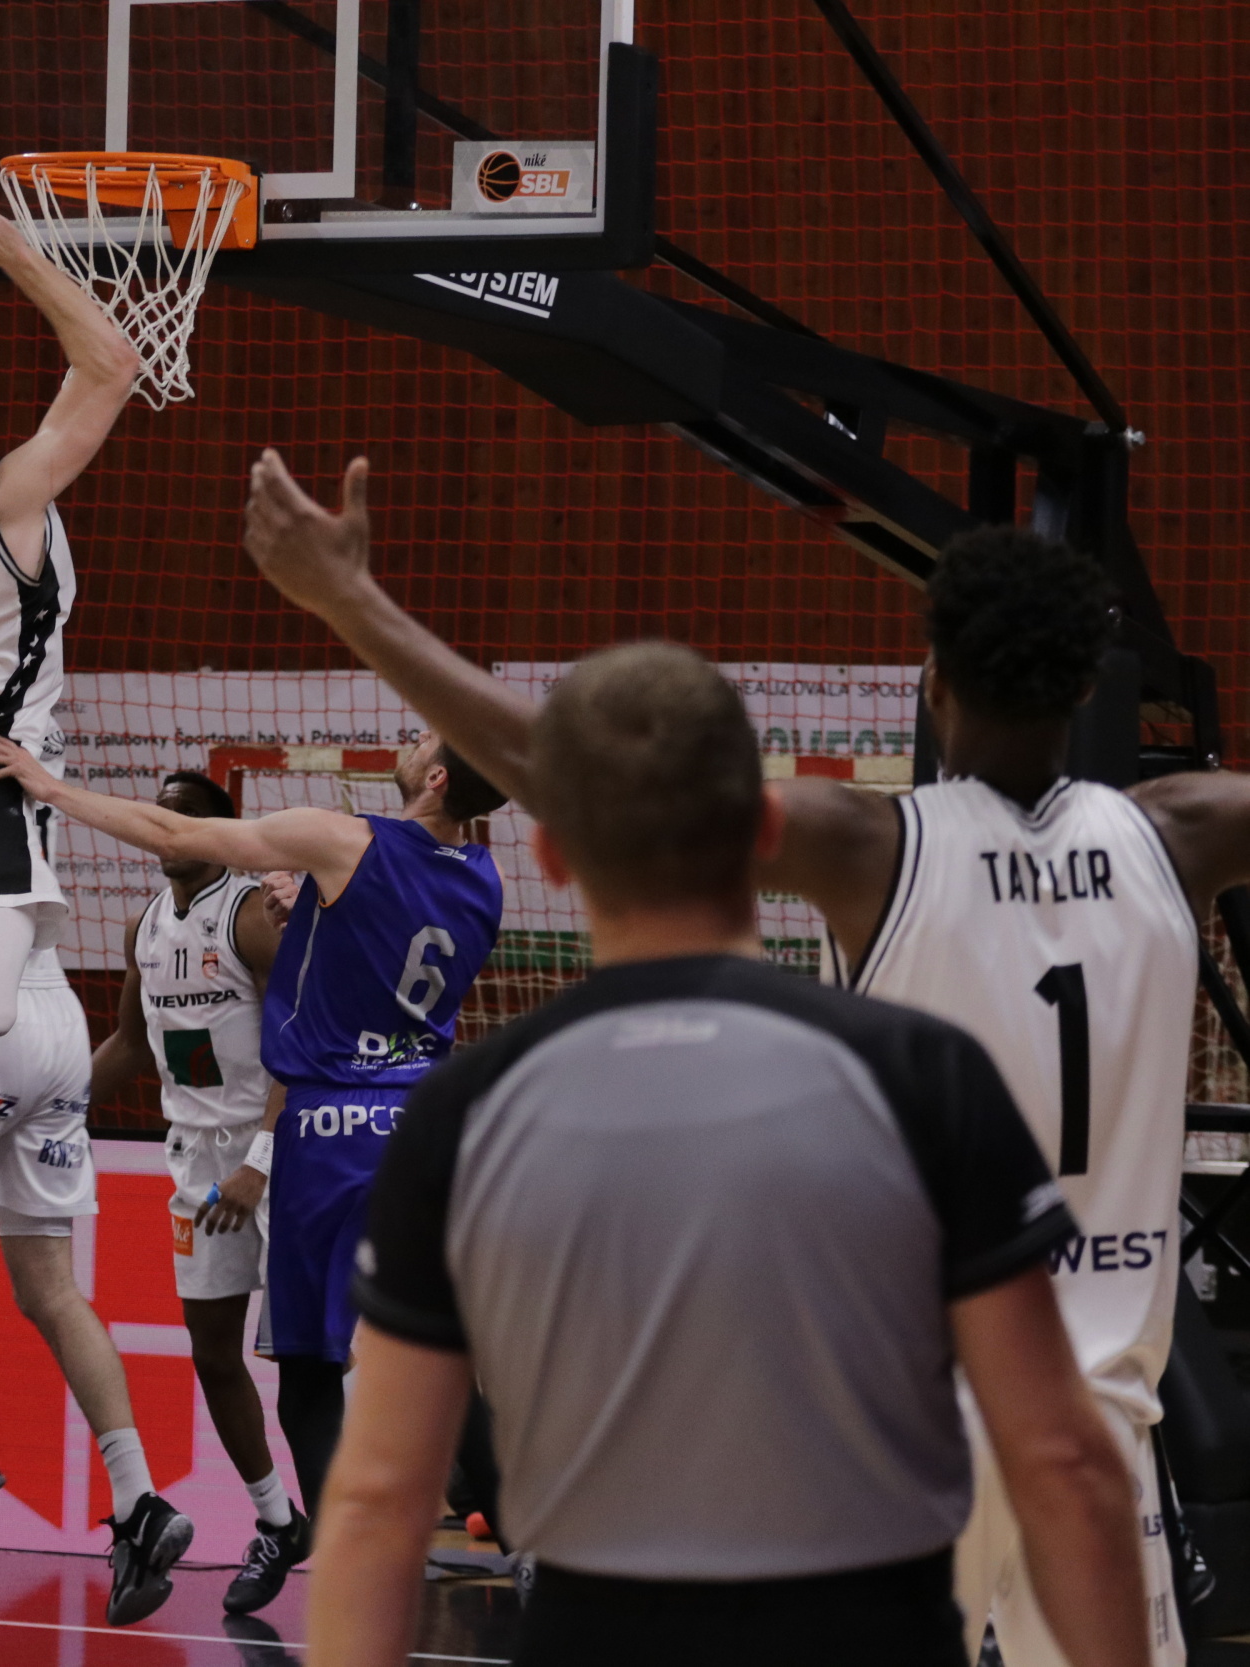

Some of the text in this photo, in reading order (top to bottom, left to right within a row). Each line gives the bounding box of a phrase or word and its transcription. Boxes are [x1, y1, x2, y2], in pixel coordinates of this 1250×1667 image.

[524, 153, 546, 167] niké
[519, 173, 565, 194] SBL
[311, 730, 379, 744] Prievidzi
[980, 849, 1114, 902] TAYLOR
[175, 948, 188, 979] 11
[395, 926, 456, 1021] 6
[1034, 962, 1090, 1177] 1
